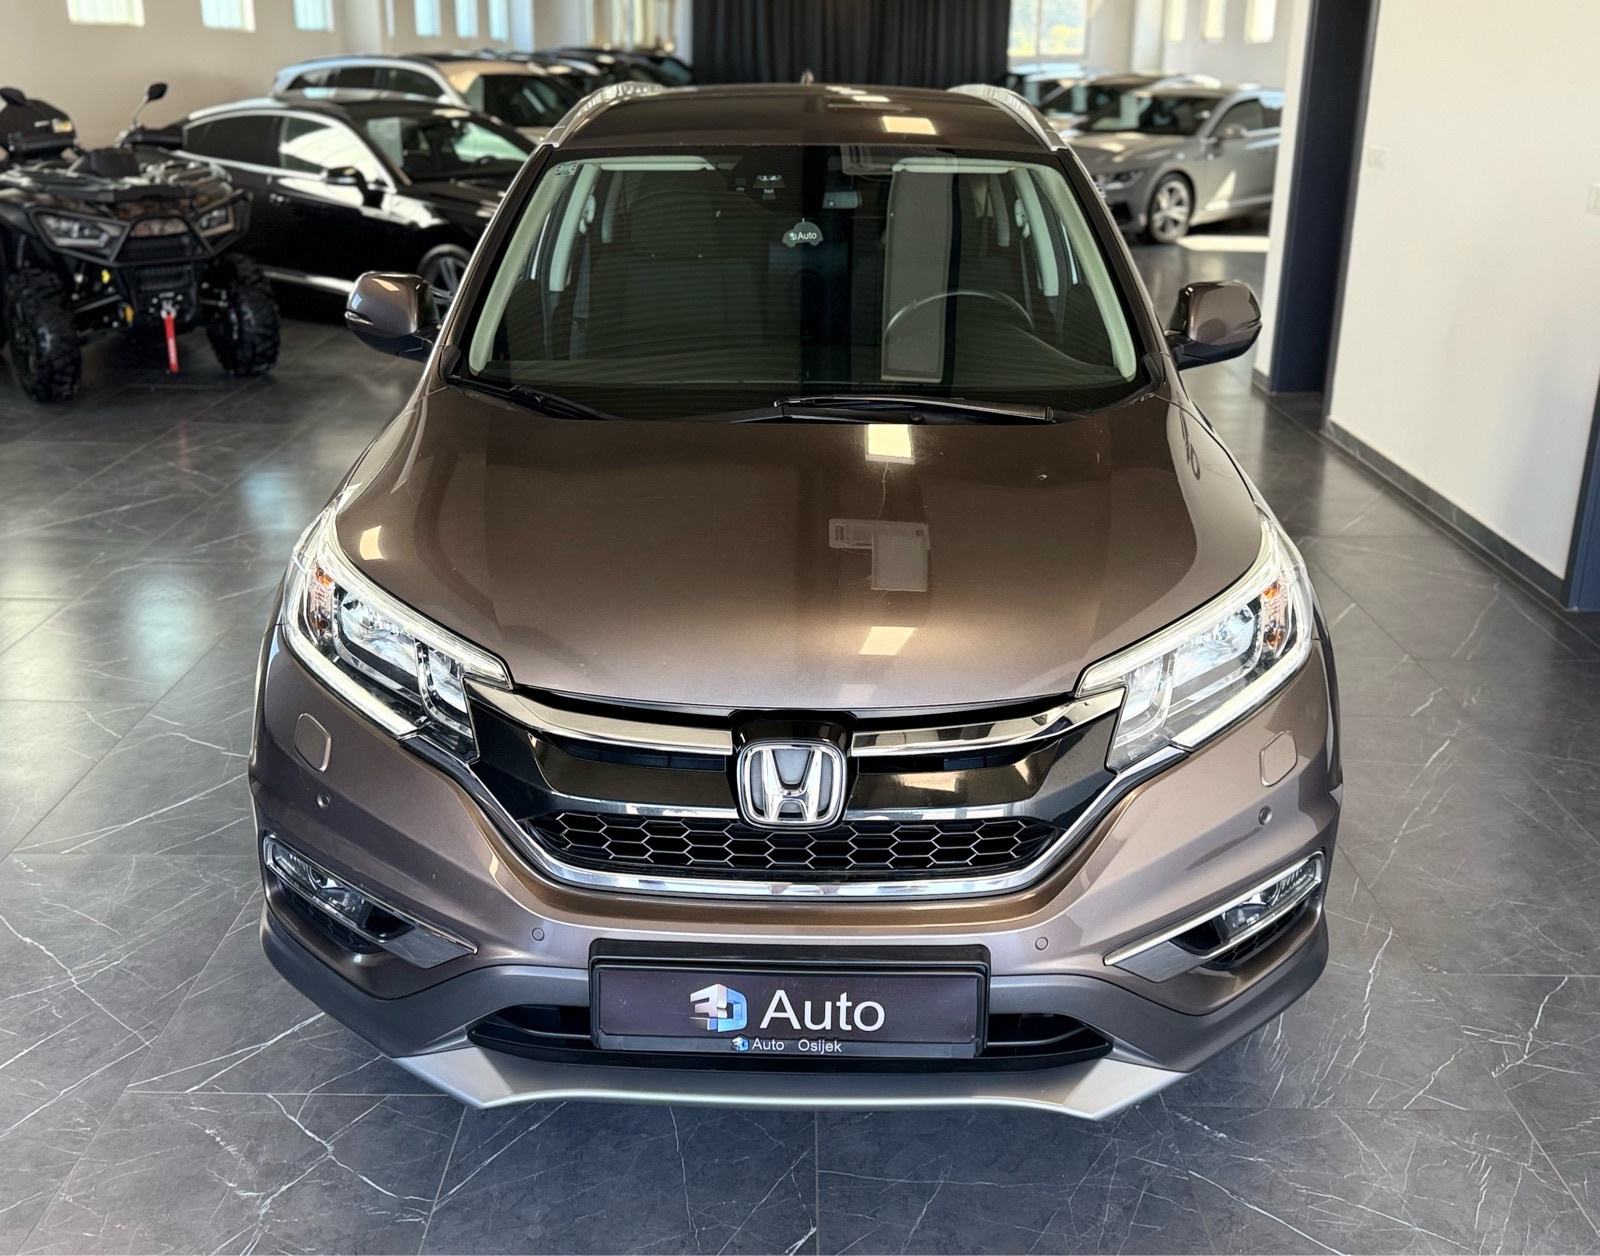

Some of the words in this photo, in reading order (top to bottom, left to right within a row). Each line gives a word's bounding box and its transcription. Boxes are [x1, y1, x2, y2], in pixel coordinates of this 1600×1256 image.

[797, 231, 817, 240] Auto
[759, 989, 886, 1032] Auto
[751, 1037, 785, 1052] Auto
[797, 1039, 843, 1055] Osijek
